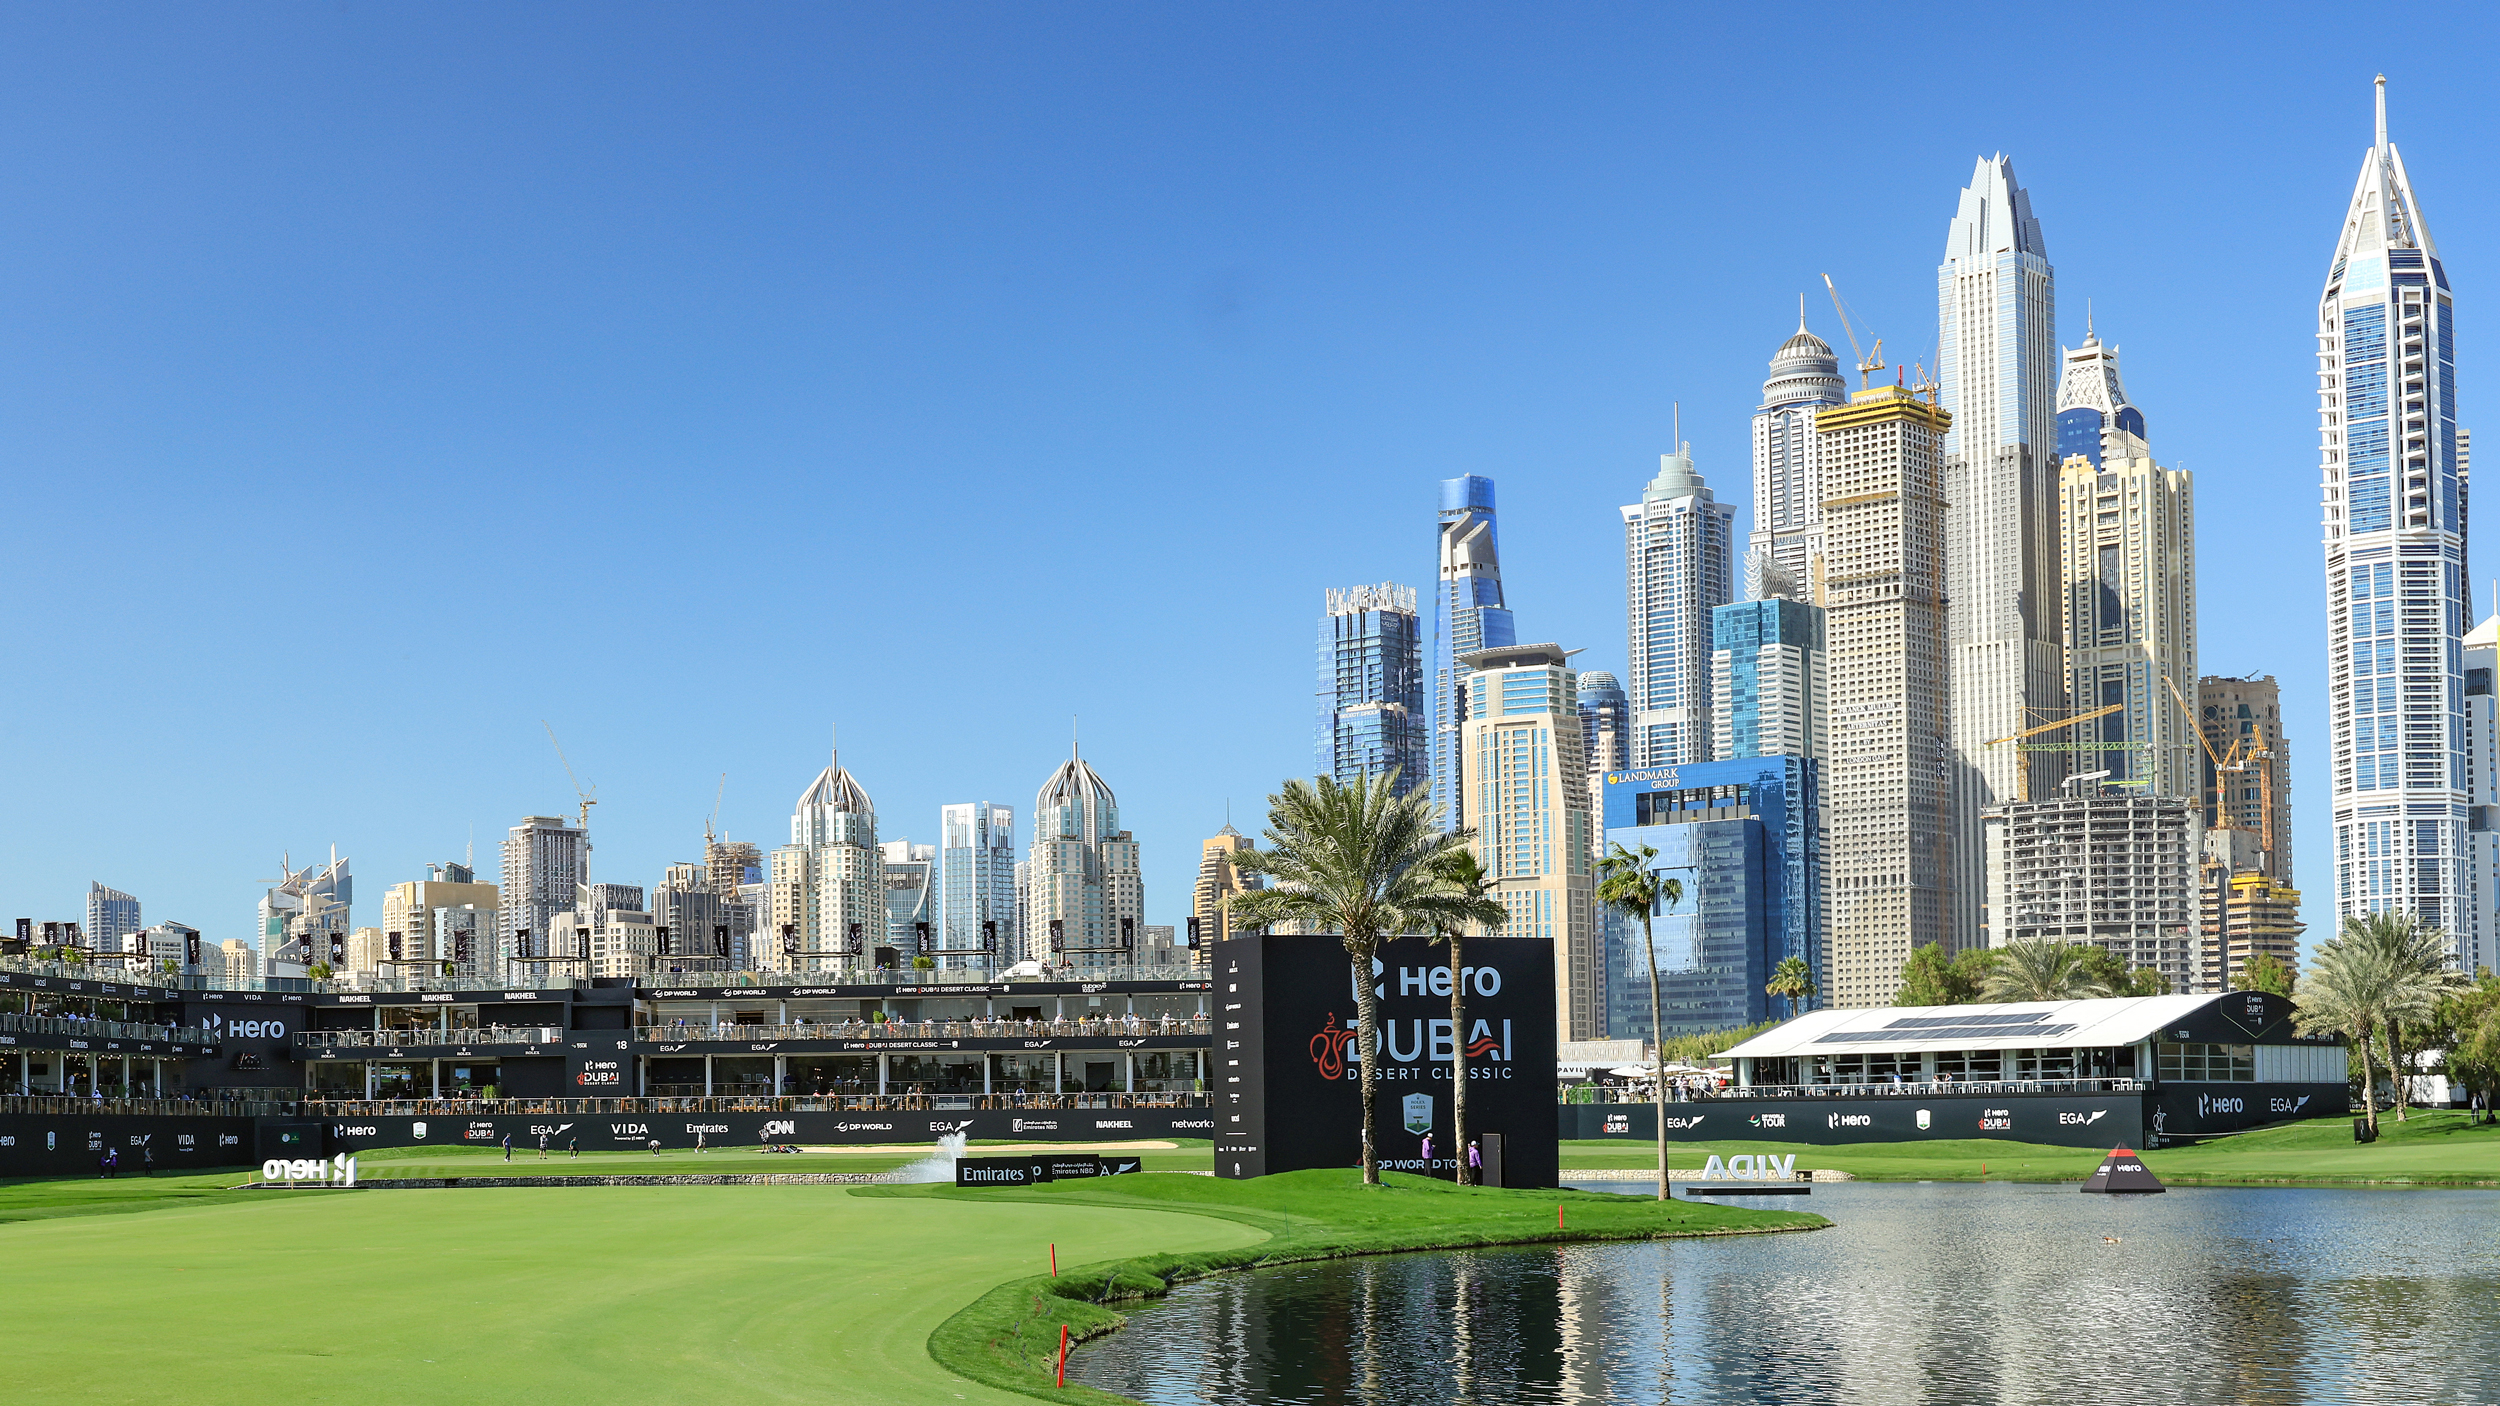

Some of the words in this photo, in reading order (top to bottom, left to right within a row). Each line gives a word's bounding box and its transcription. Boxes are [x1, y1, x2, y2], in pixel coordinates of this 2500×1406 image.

[1838, 705, 1867, 714] FRANCK
[1867, 702, 1896, 711] MULLER
[1846, 755, 1872, 764] LONDON
[1618, 768, 1679, 784] LANDMARK
[1650, 778, 1680, 789] GROUP
[607, 890, 643, 905] EMAAR
[35, 978, 46, 986] wasl
[1400, 966, 1502, 997] Hero
[229, 1020, 285, 1038] Hero
[0, 1034, 15, 1044] mirates
[70, 1039, 88, 1048] Emirates
[1346, 1019, 1512, 1062] DUBAI
[616, 1040, 628, 1050] 18
[584, 1072, 619, 1082] DUBAI
[1348, 1068, 1420, 1080] DSERT
[1432, 1068, 1512, 1080] CLSSIC
[2212, 1098, 2244, 1113] Hero
[2270, 1098, 2293, 1112] EGA
[1667, 1118, 1688, 1128] EGA
[1841, 1114, 1871, 1126] Hero
[1984, 1118, 2010, 1127] DUBAI
[2059, 1112, 2085, 1124] EGA
[686, 1123, 728, 1134] Emirates
[766, 1120, 794, 1135] CNN
[930, 1122, 954, 1131] EGA
[1172, 1120, 1210, 1128] network
[1607, 1122, 1628, 1130] DUBAI
[1762, 1119, 1785, 1128] TOUR
[347, 1126, 377, 1136] Hero
[530, 1125, 554, 1134] EGA
[611, 1124, 648, 1134] VIDA
[130, 1136, 141, 1145] EGA
[178, 1135, 195, 1145] VIDA
[225, 1136, 238, 1144] Hero
[1394, 1159, 1442, 1170] WORD
[1443, 1158, 1457, 1171] TO
[963, 1166, 1024, 1181] Emirates
